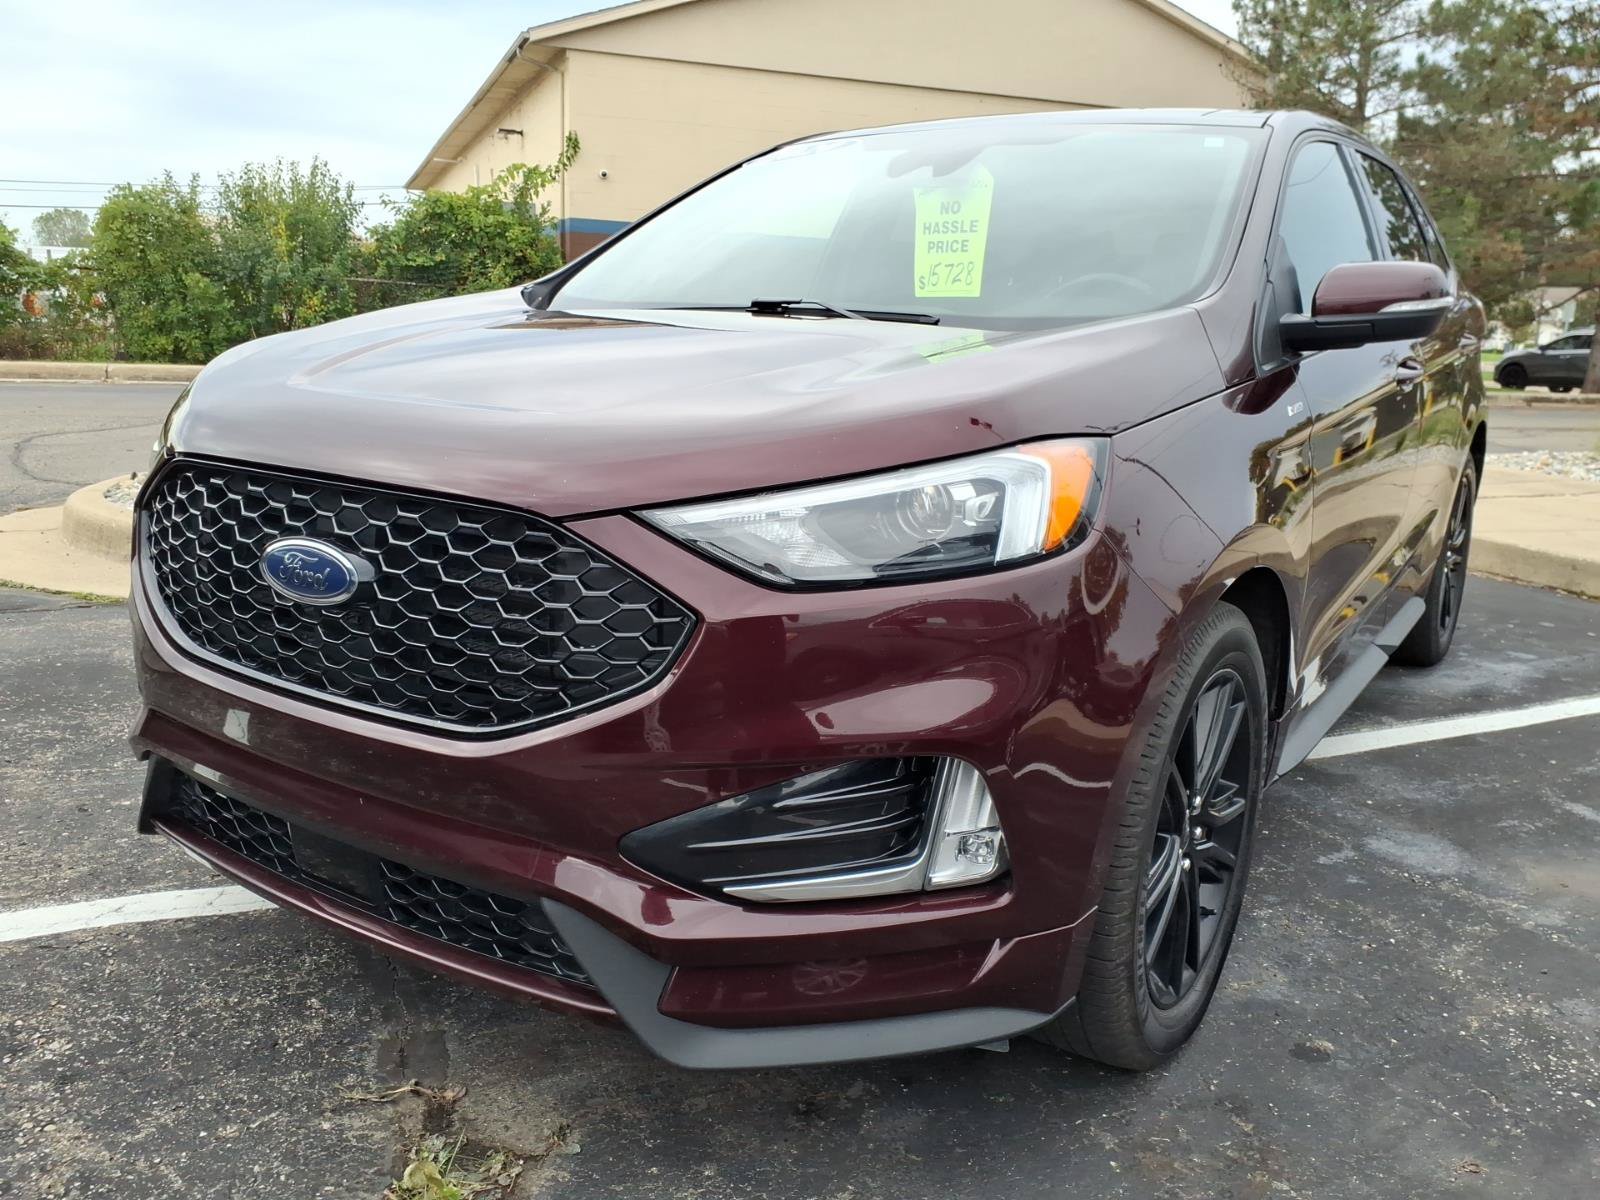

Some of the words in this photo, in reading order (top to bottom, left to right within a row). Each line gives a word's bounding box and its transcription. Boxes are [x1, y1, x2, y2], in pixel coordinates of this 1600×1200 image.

[940, 200, 962, 215] NO
[922, 220, 979, 235] HASSLE
[927, 239, 970, 254] PRICE
[279, 551, 331, 591] Ford
